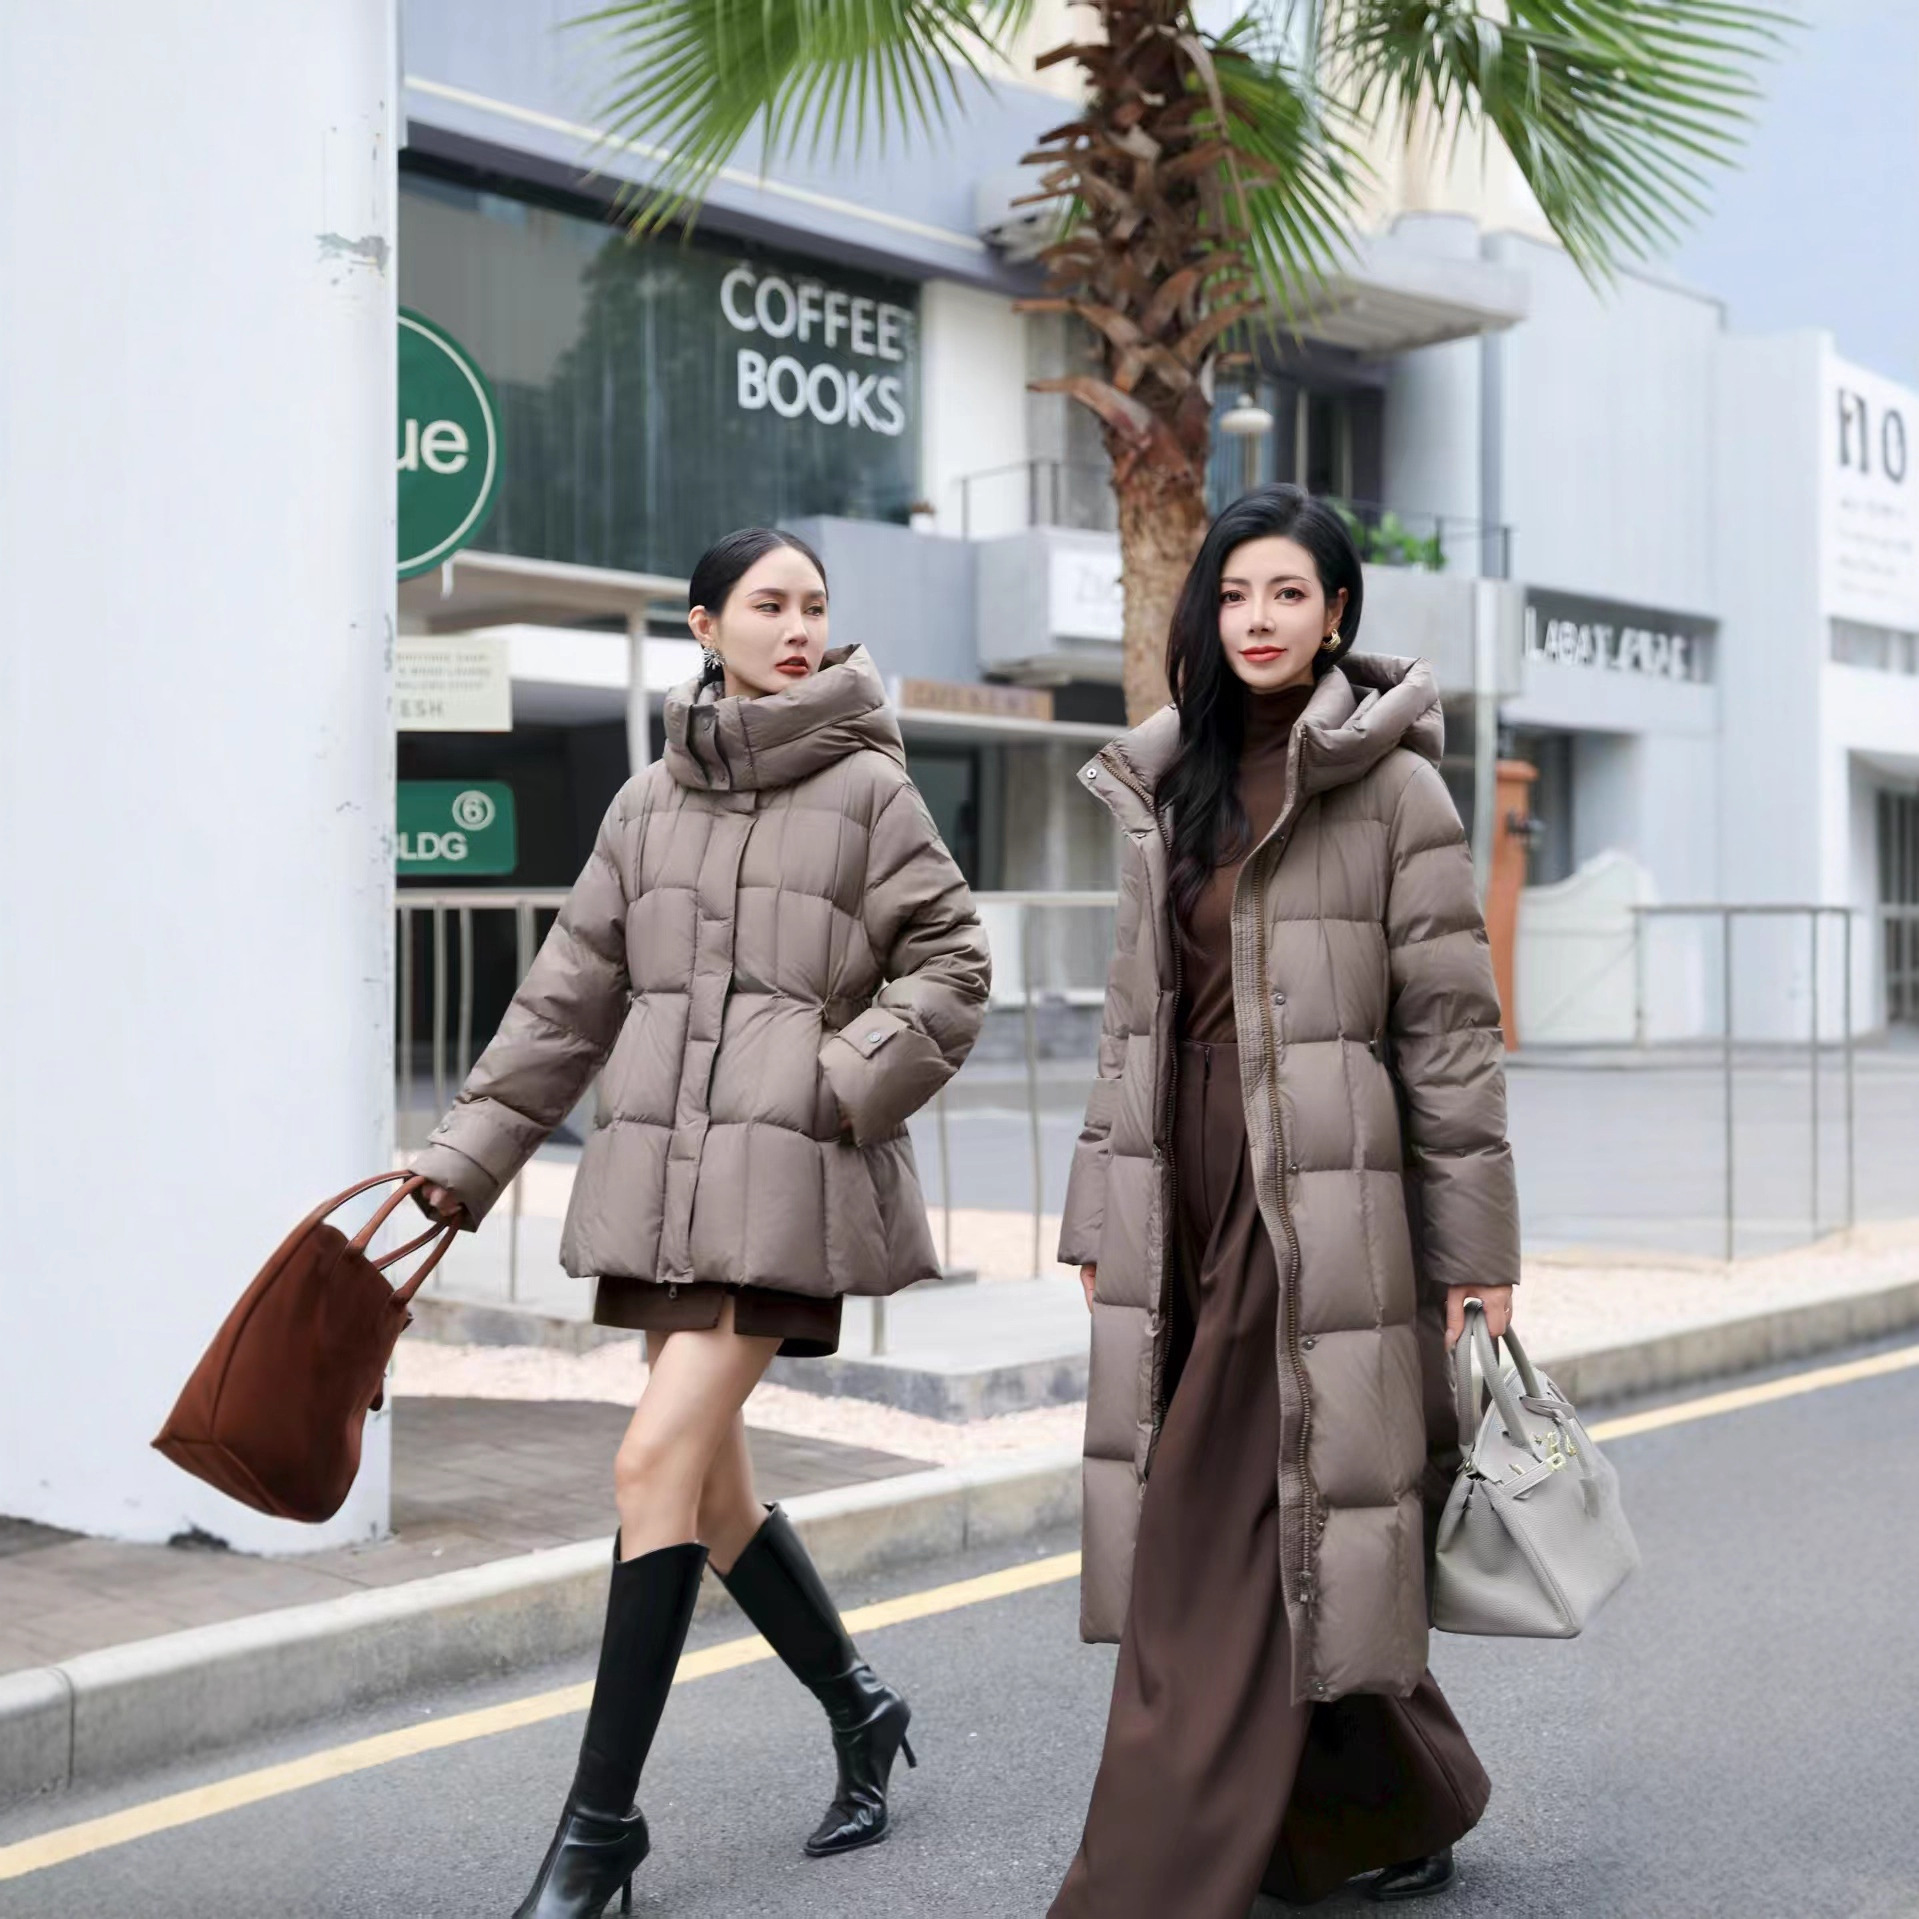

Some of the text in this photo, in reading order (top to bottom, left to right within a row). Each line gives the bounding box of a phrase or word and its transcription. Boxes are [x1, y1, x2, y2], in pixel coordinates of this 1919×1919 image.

[719, 267, 905, 362] COFFEE
[737, 348, 905, 436] BOOKS
[397, 831, 469, 861] LDG
